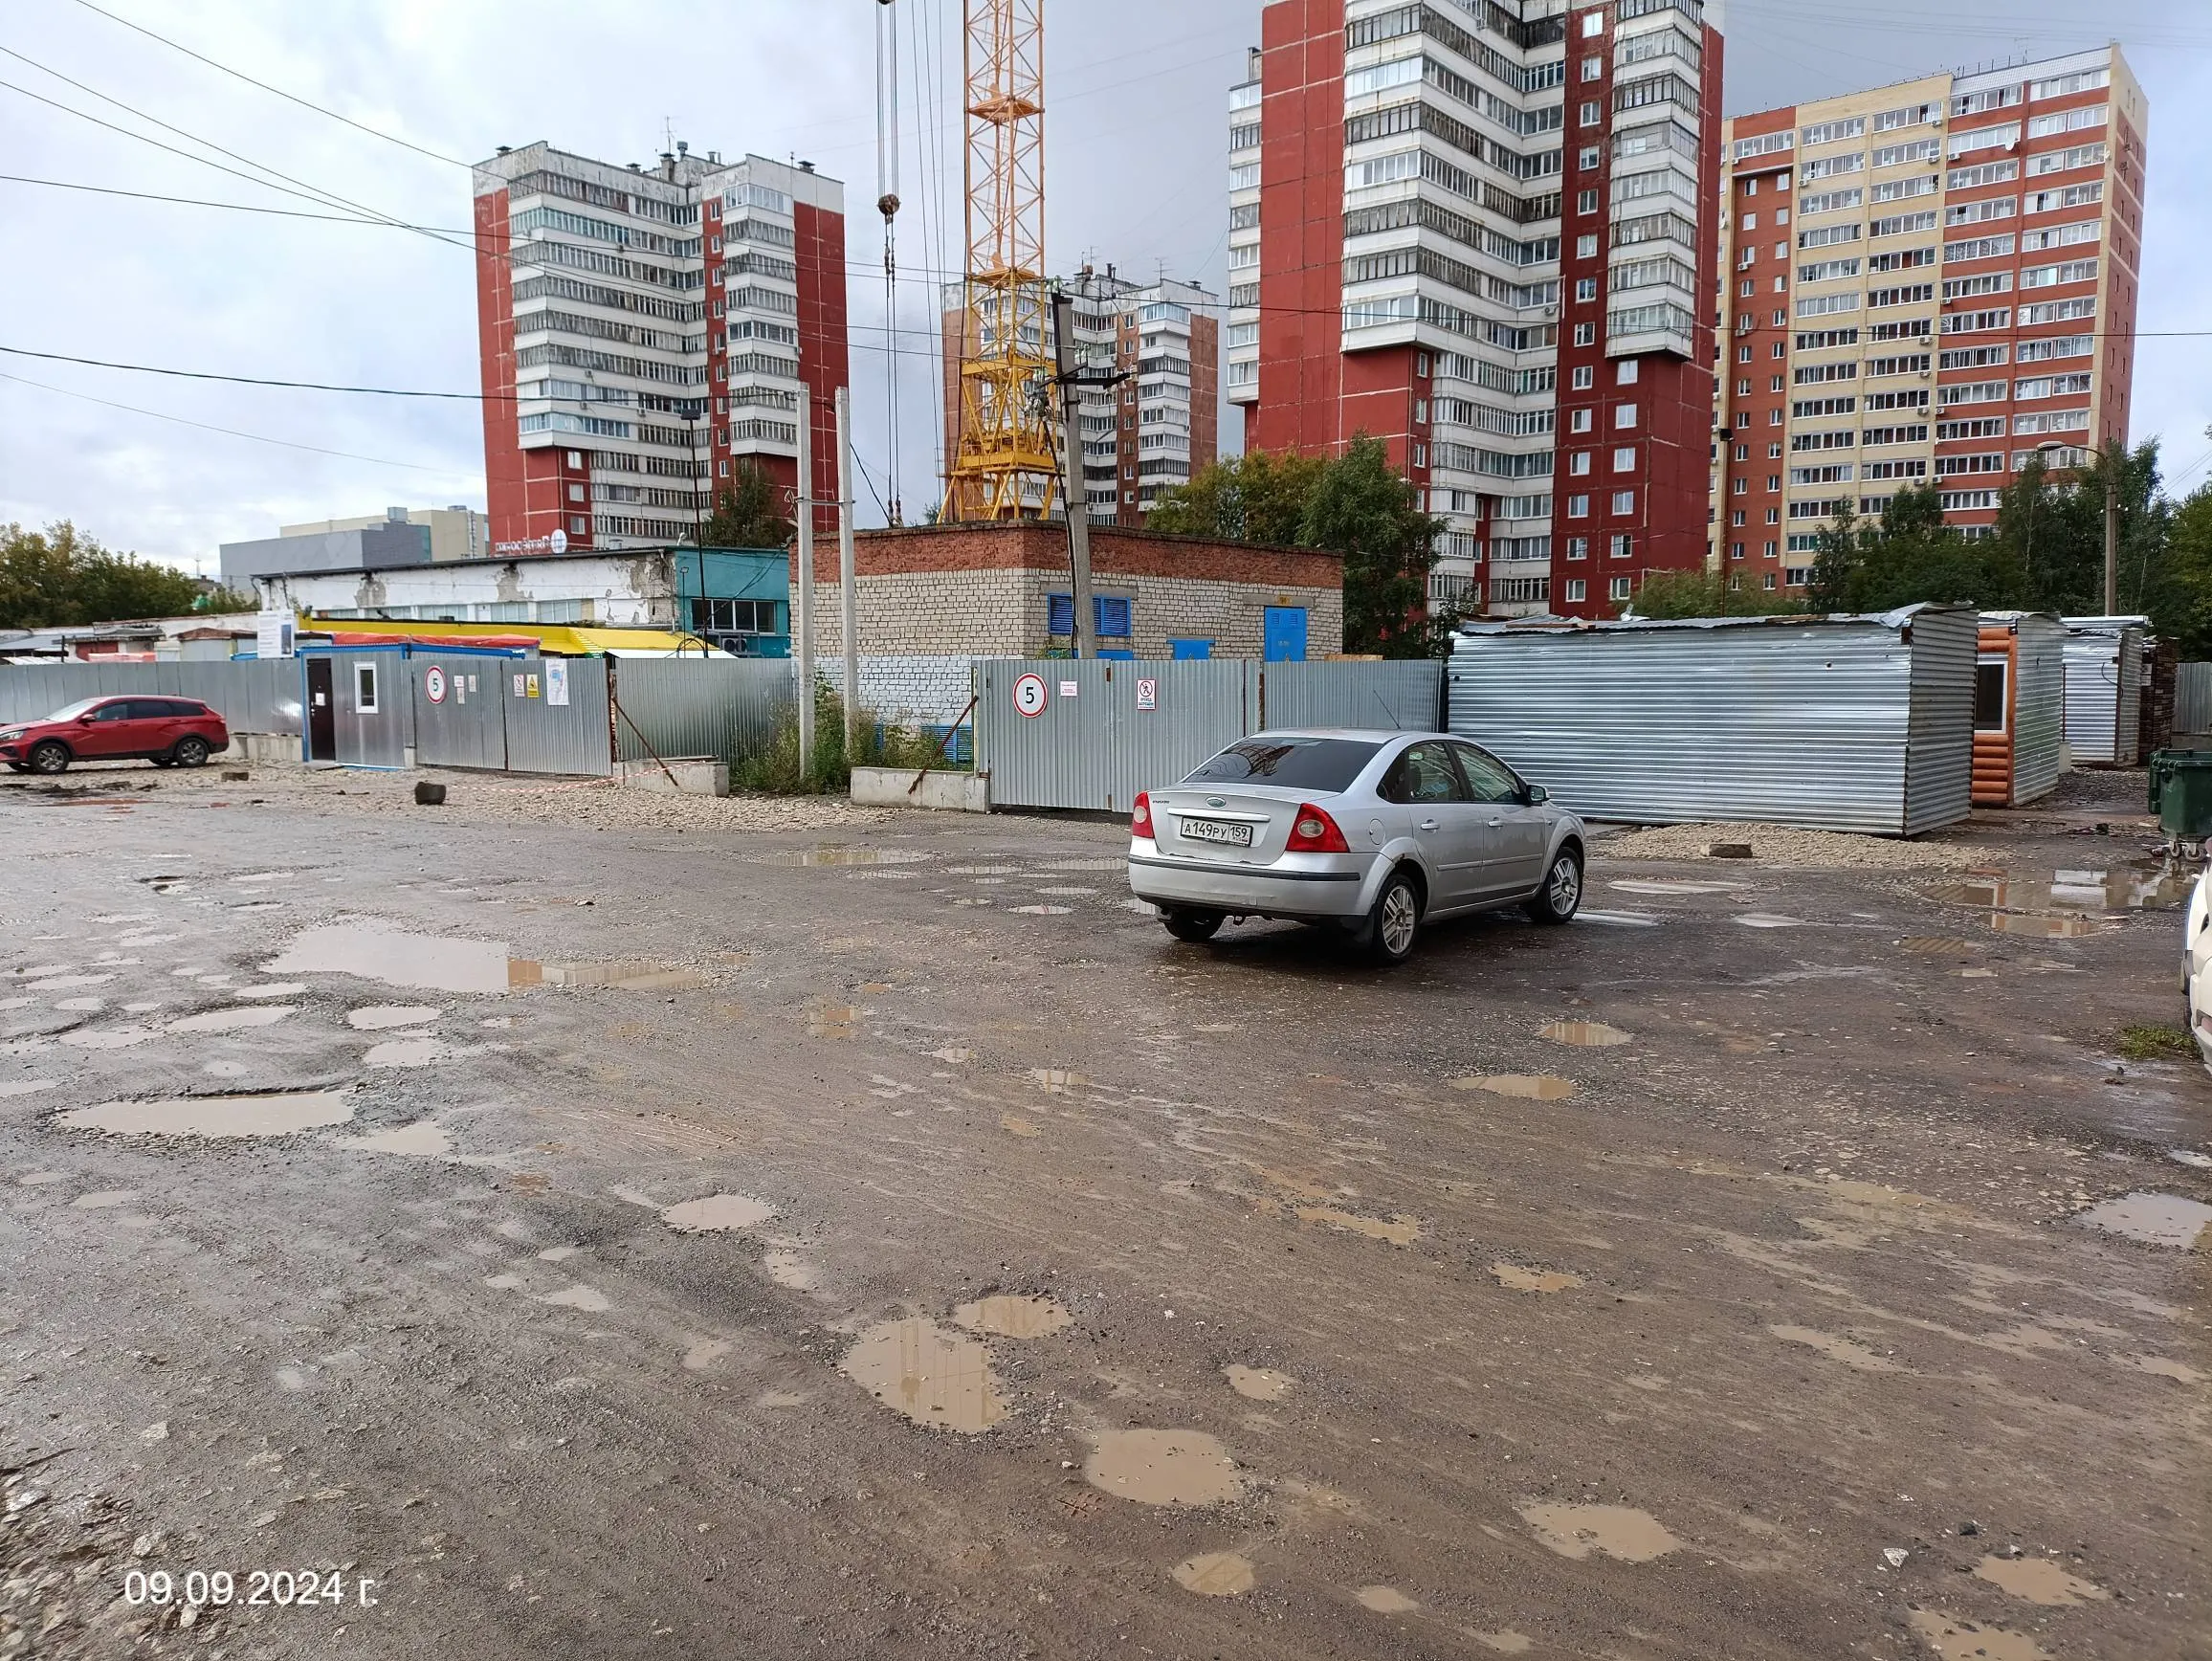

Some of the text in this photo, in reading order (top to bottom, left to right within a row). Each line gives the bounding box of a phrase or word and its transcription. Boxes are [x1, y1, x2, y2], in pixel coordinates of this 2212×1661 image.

[432, 677, 439, 692] 5
[1025, 686, 1035, 704] 5
[1184, 822, 1248, 838] А149РУ 159
